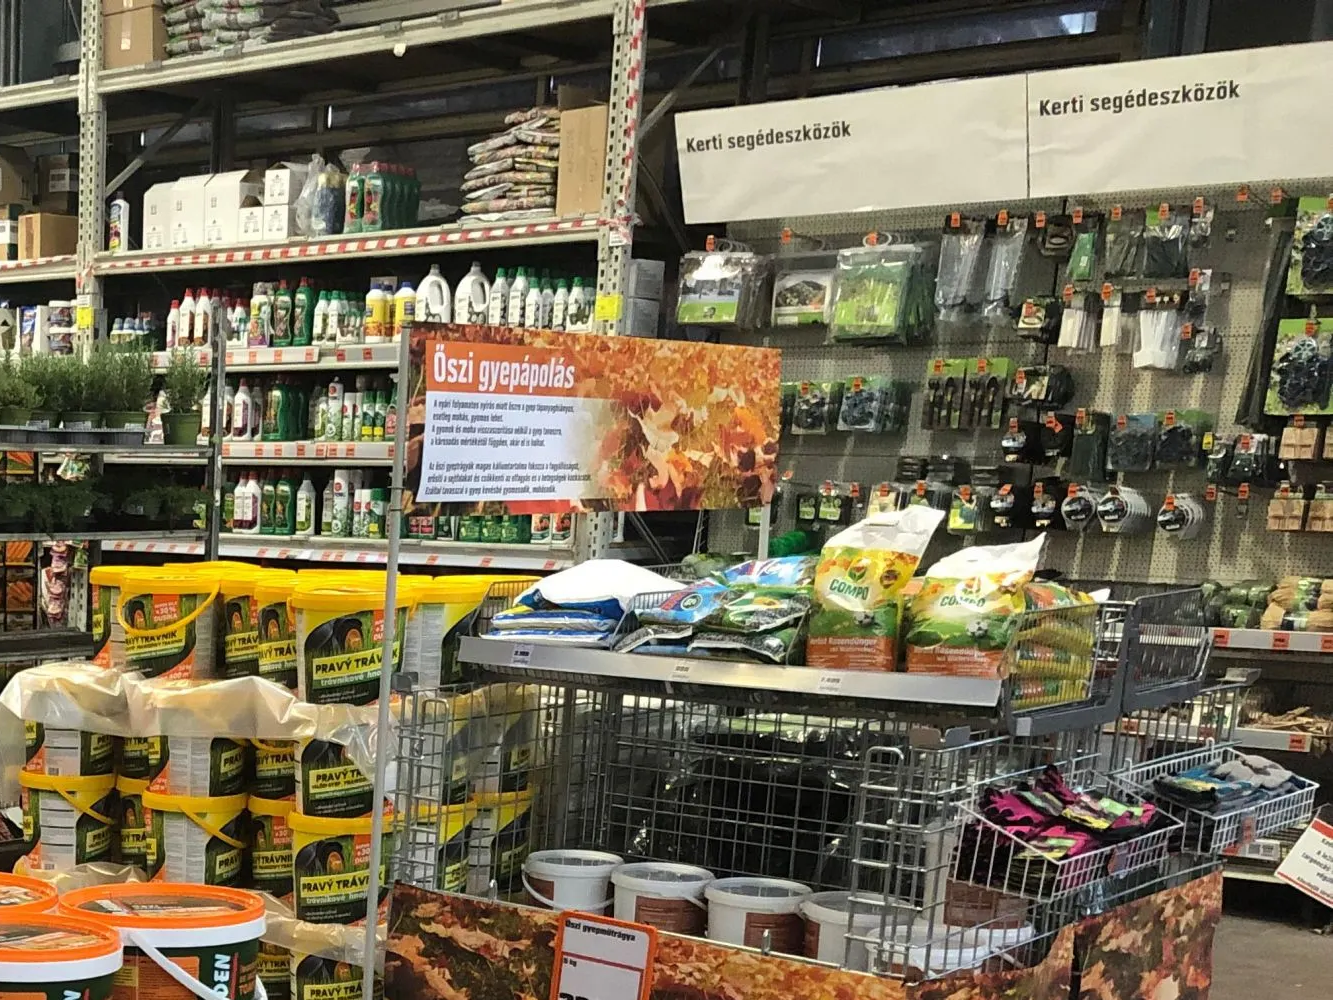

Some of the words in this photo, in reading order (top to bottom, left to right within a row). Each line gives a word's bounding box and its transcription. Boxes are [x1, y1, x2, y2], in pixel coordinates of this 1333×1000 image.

[1039, 96, 1084, 117] Kerti
[1090, 81, 1240, 113] segédeszközök
[686, 134, 723, 154] Kerti
[728, 121, 852, 151] segédeszközök
[434, 344, 473, 383] Őszi
[478, 355, 575, 392] gyepápolás
[829, 578, 869, 600] COMPO
[315, 661, 354, 674] PRAVÝ
[316, 769, 348, 782] PRAVÝ
[302, 880, 333, 892] PRAVÝ
[582, 924, 636, 941] gyepműtrágya
[310, 987, 341, 998] PRAVÝ
